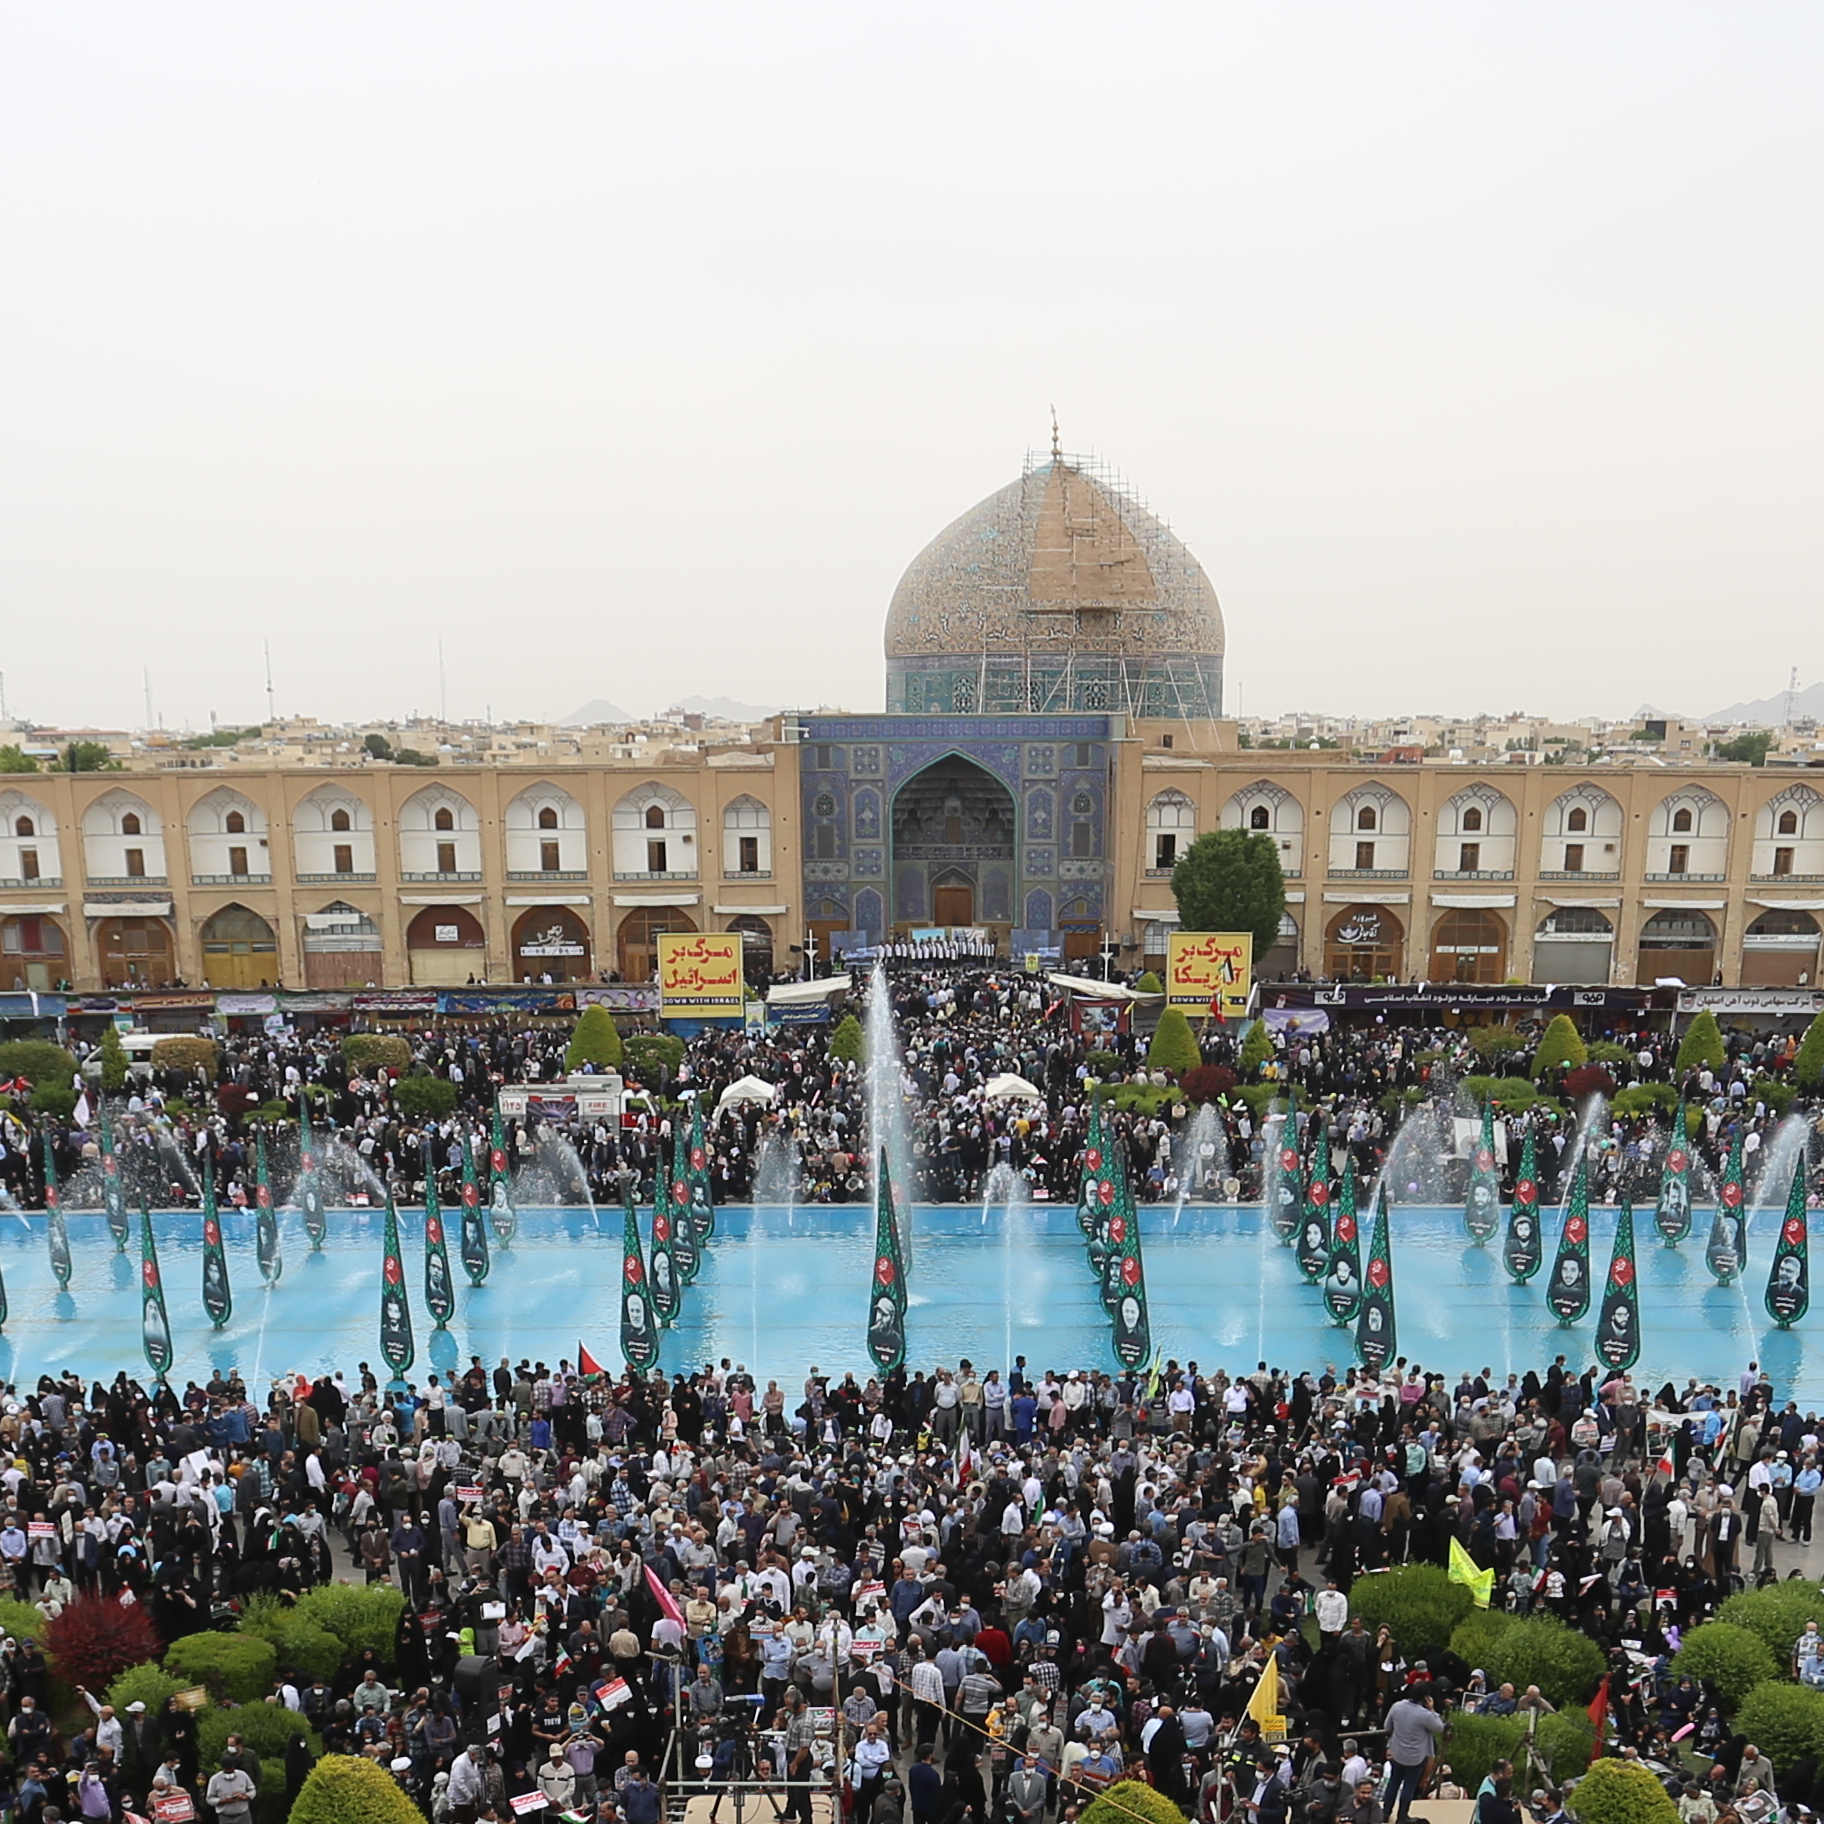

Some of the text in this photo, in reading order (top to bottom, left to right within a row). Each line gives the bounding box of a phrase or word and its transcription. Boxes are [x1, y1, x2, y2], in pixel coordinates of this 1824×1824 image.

[666, 937, 733, 963] مرگ بر
[1175, 936, 1243, 962] مرگ بر
[664, 967, 738, 991] اسرائیل
[1364, 994, 1404, 1004] اسلامی
[1405, 993, 1431, 1004] انقلاب
[1458, 993, 1494, 1004] مبارکه
[1495, 993, 1521, 1004] فولاد
[1697, 996, 1810, 1008] شرکت سهامی ذوب آهن اصفهان
